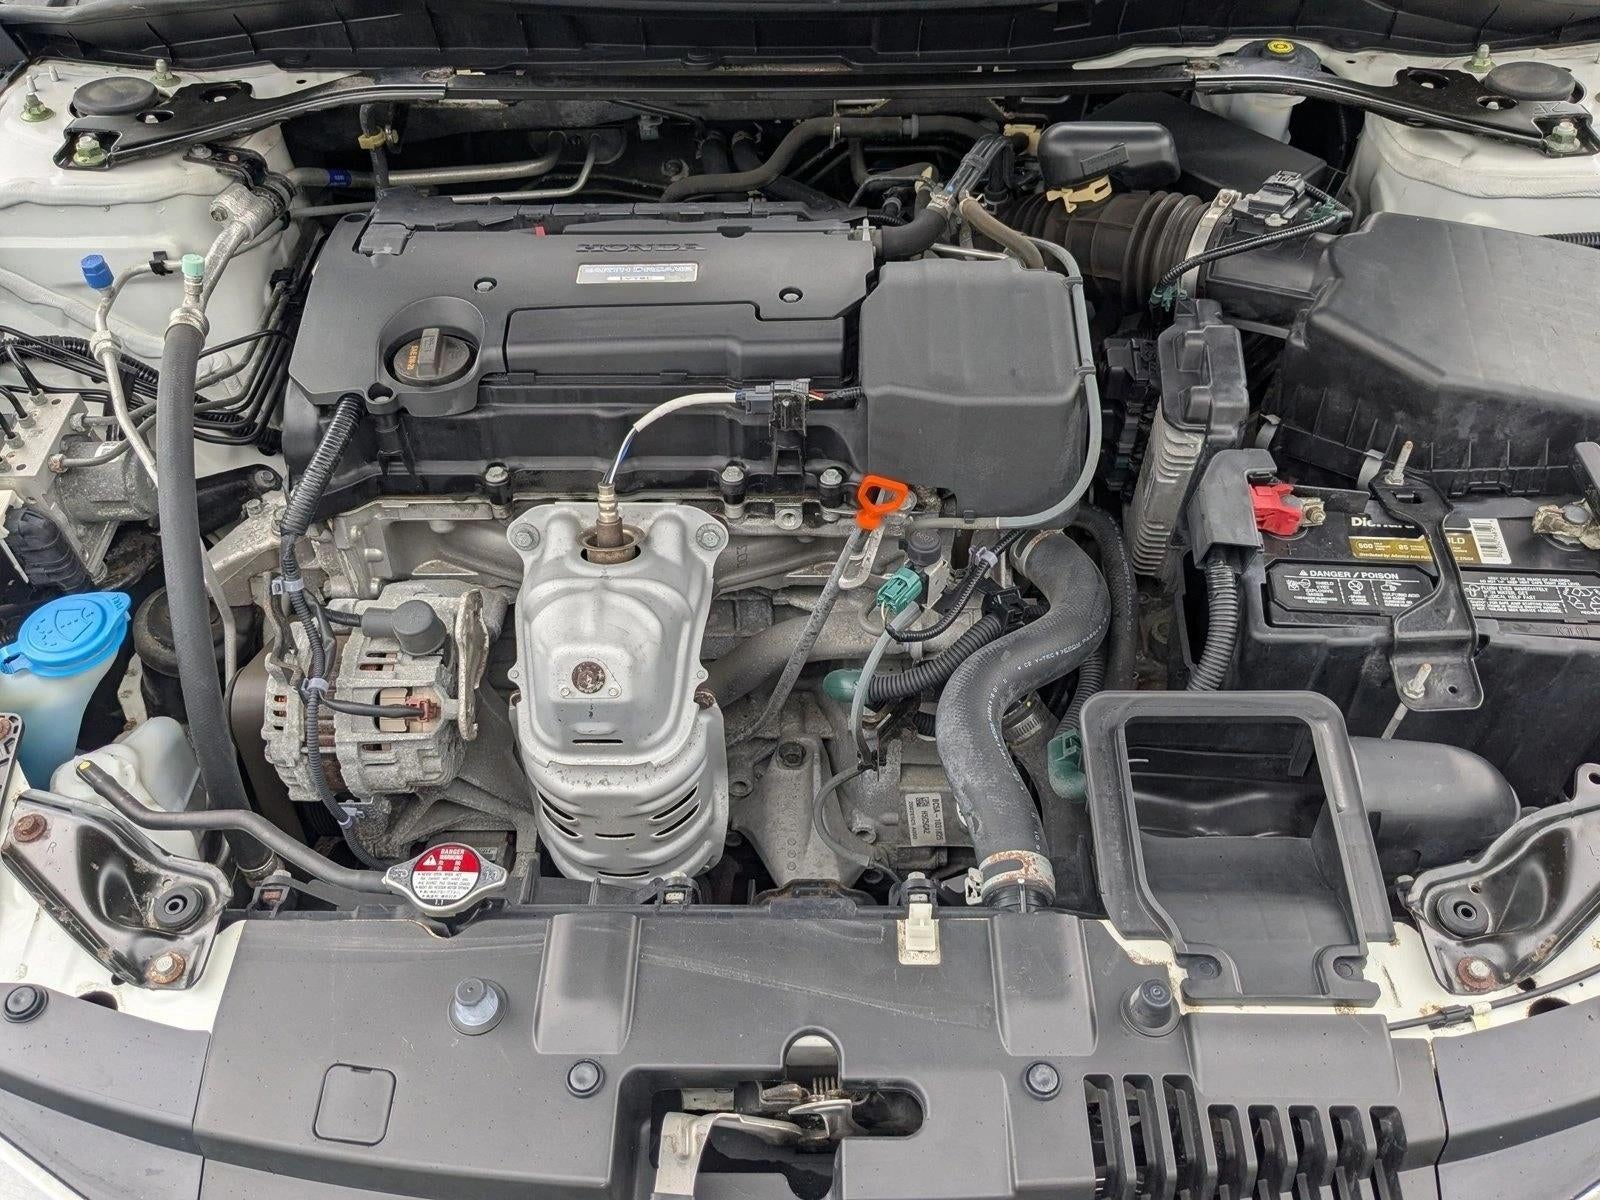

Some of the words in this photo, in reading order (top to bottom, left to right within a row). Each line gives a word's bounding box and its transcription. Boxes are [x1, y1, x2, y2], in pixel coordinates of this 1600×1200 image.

[576, 243, 707, 253] HONDA
[1309, 570, 1352, 578] DANGER
[1360, 571, 1400, 580] POISON
